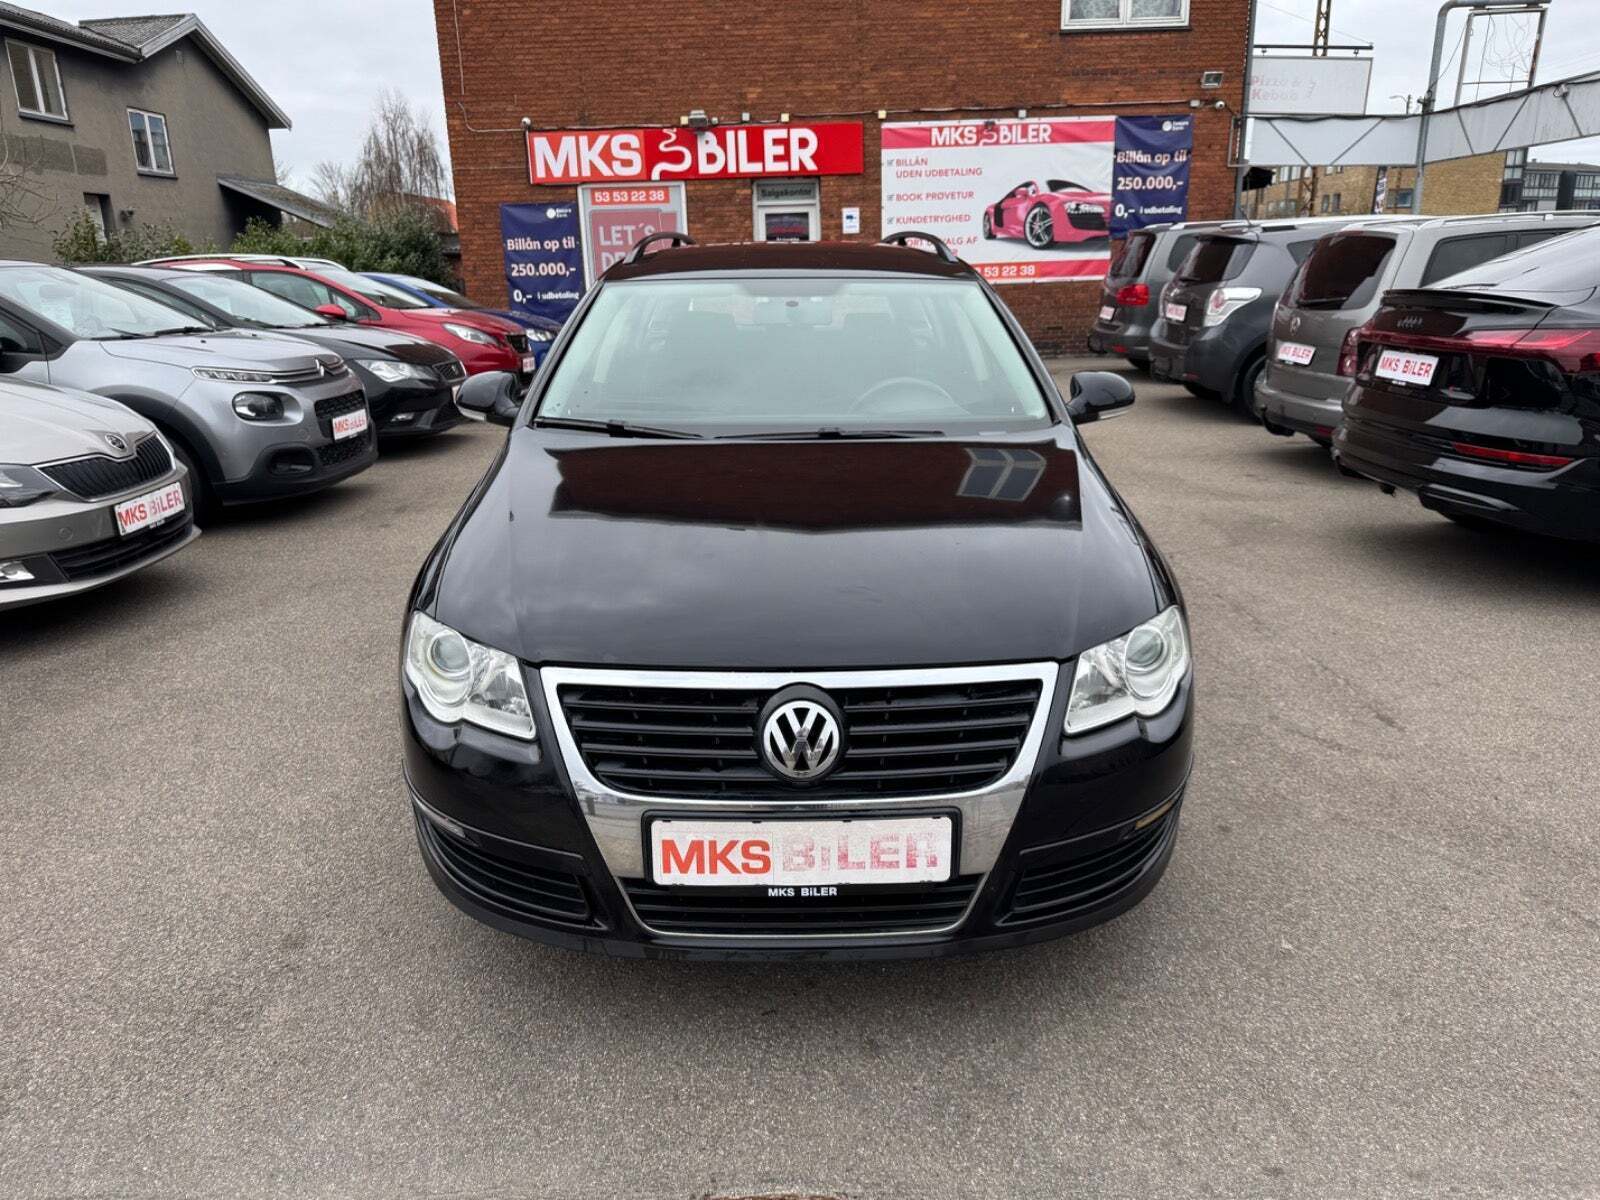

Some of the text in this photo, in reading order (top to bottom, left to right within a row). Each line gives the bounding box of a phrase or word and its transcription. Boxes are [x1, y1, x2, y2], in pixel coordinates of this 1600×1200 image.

[931, 124, 1052, 146] MKS BILER
[533, 128, 818, 178] MKS BILER
[1117, 149, 1187, 166] Billån op til
[896, 167, 983, 179] UDEN UDBETALING
[1116, 175, 1184, 191] 250.000,-
[594, 190, 664, 202] 53 53 22 38
[896, 191, 975, 202] BOOK PRØVETUR
[896, 213, 972, 225] KUNDETRYGHED
[507, 236, 576, 253] Billån op til
[511, 262, 577, 278] 250.000,-
[983, 266, 999, 277] 53
[1001, 265, 1017, 276] 22
[1020, 264, 1036, 276] 38
[117, 503, 148, 528] MKS
[661, 839, 772, 875] MKS
[767, 887, 795, 898] MKS
